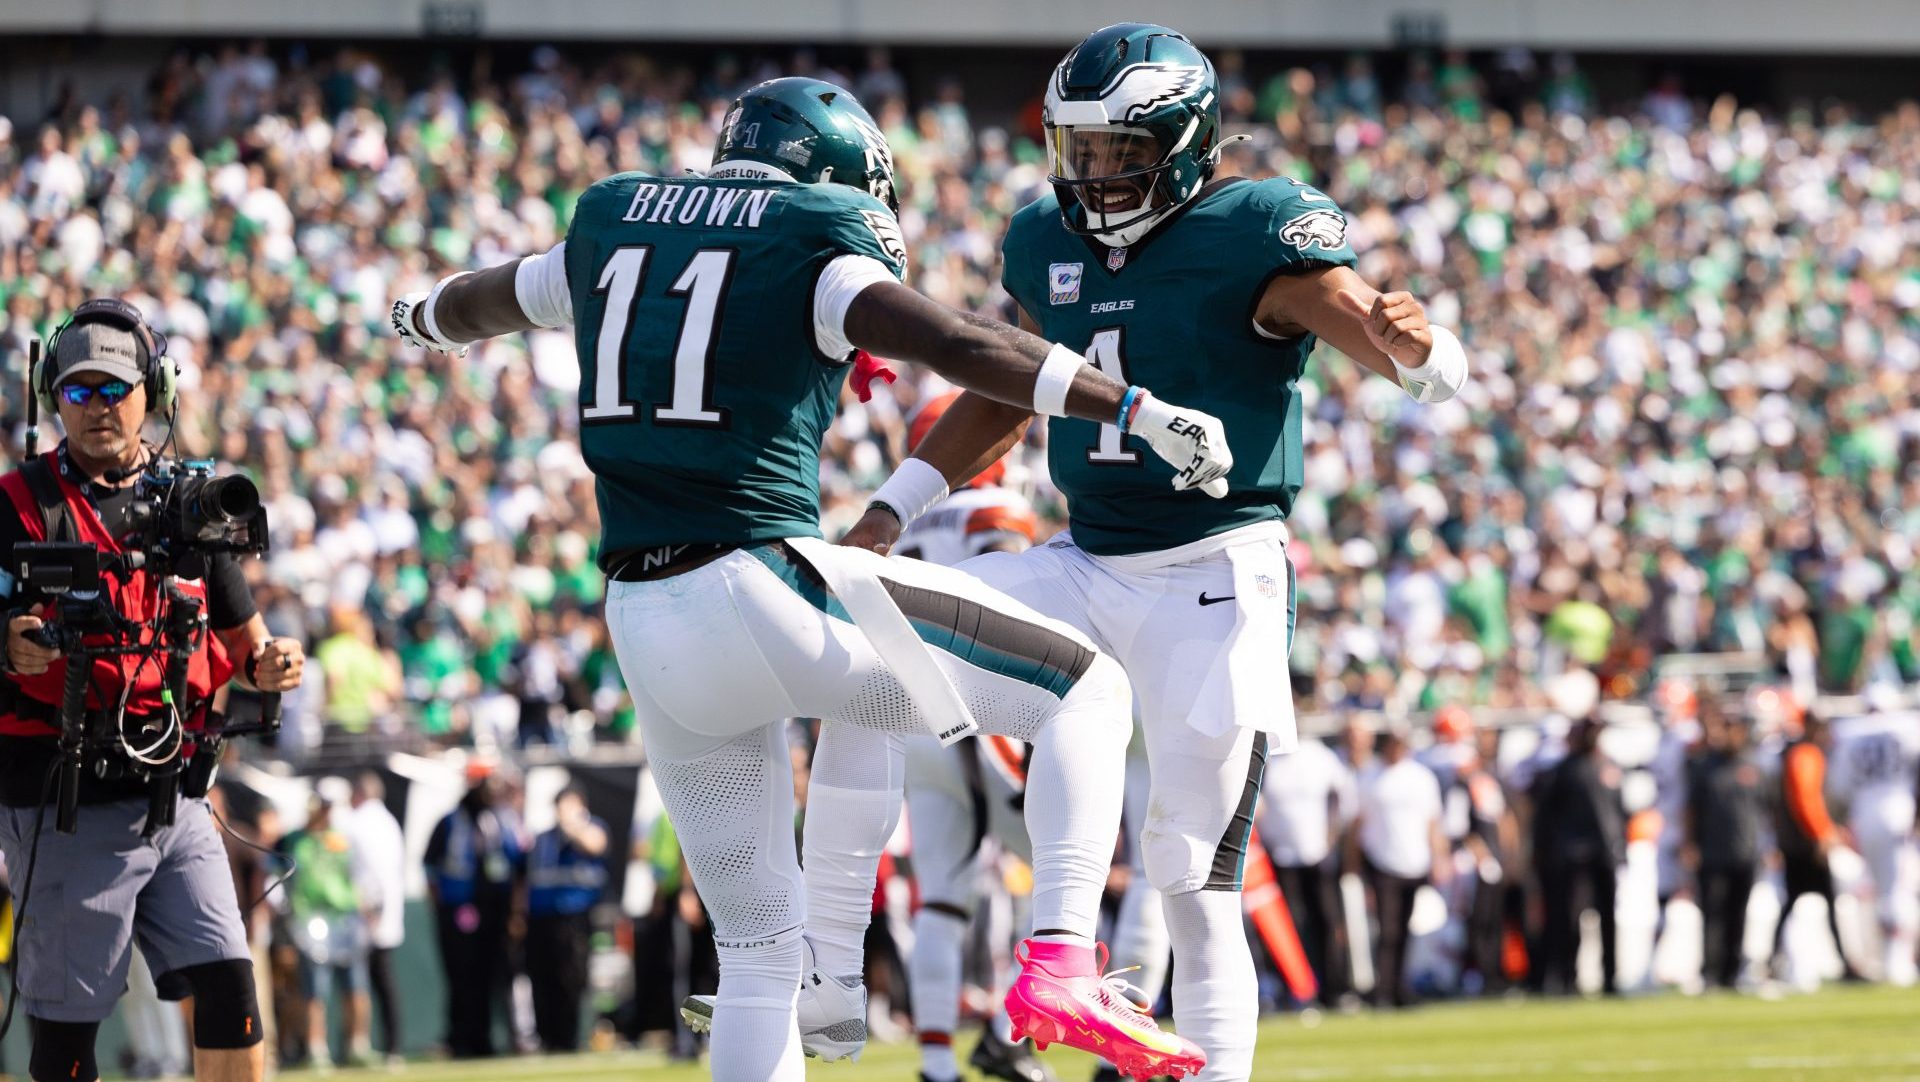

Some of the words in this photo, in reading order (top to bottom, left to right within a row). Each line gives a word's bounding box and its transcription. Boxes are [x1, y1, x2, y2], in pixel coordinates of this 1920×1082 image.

[739, 168, 769, 180] LOVE
[621, 183, 781, 229] BROWN
[1090, 299, 1136, 314] EAGLES
[579, 245, 737, 427] 11
[1084, 327, 1141, 464] 1
[938, 731, 951, 741] WE
[950, 722, 970, 735] BALL.
